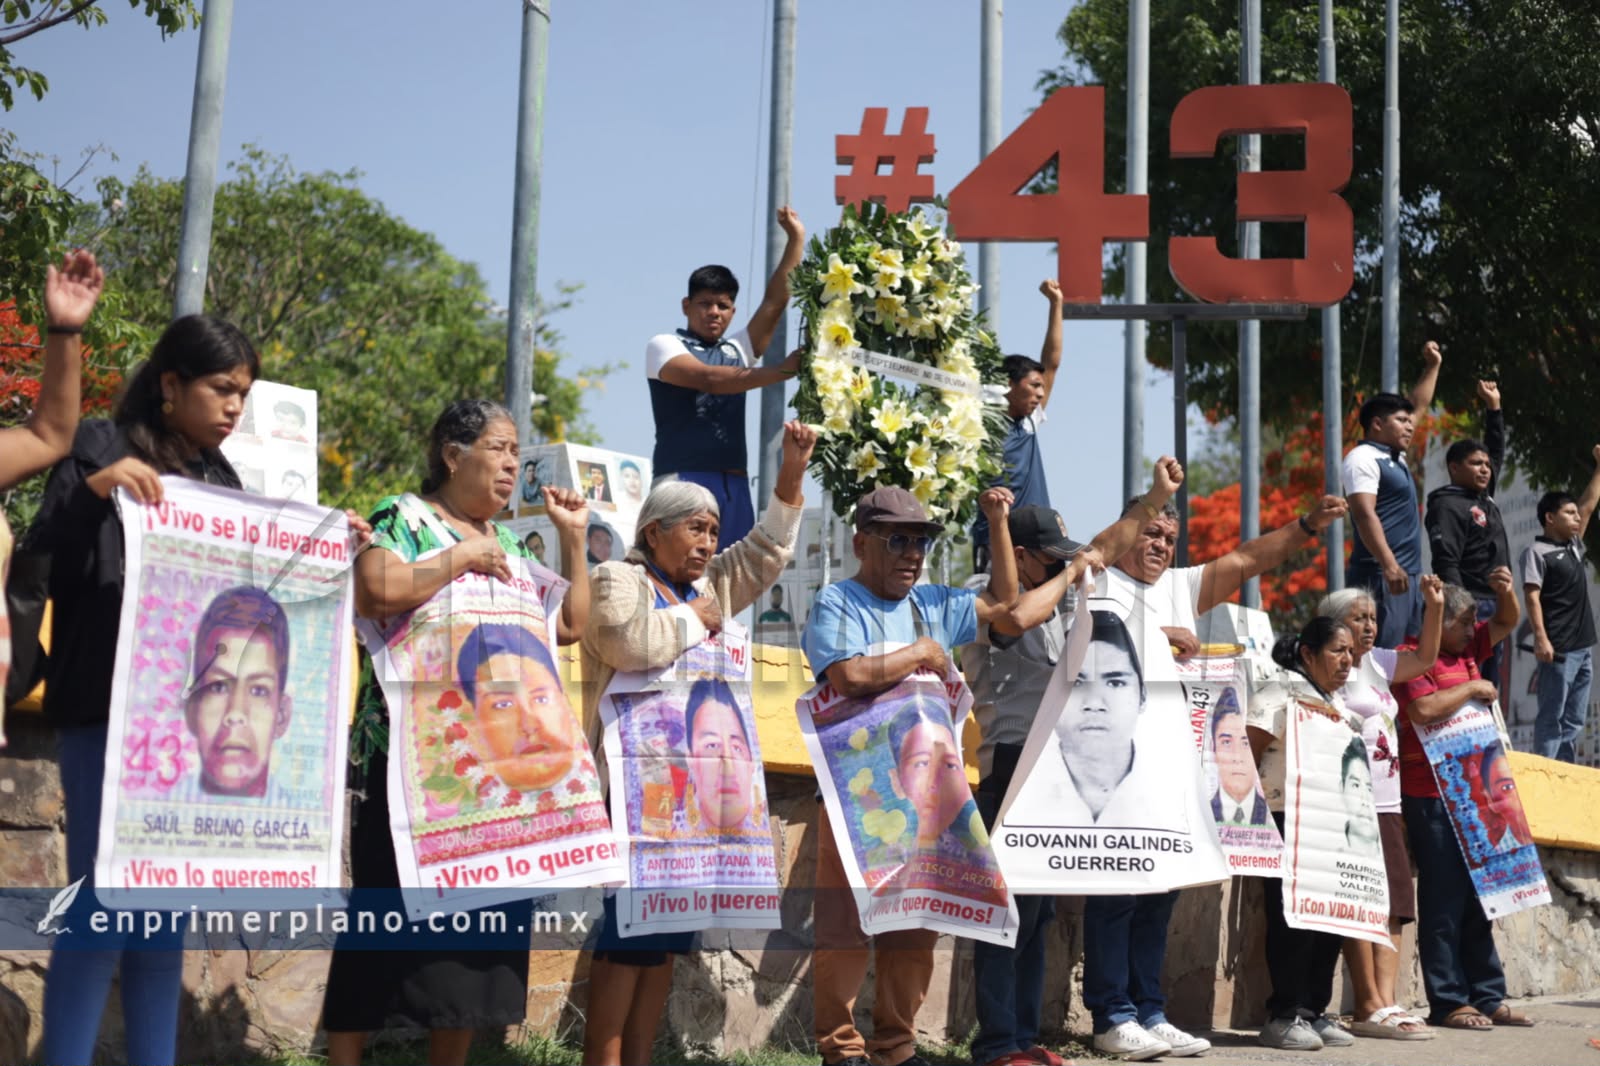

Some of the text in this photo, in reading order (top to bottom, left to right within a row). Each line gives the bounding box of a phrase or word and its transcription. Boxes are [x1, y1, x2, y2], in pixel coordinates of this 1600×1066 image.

[211, 516, 236, 539] se
[242, 516, 261, 545] lo
[267, 520, 350, 563] llevaron!
[125, 733, 182, 787] 43
[143, 811, 311, 840] SAÚL BRUNO GARCÍA
[495, 812, 572, 837] TRUJILLO
[1005, 833, 1193, 854] GIOVANNI GALINDES
[647, 856, 696, 871] ANTONIO
[701, 854, 751, 868] SANTANA
[1048, 855, 1155, 873] GUERRERO
[1229, 853, 1282, 870] queremos!
[1336, 861, 1386, 879] MAURICIO
[124, 860, 317, 895] ¡Vivo lo queremos!
[434, 865, 499, 899] ¡Vivo
[506, 855, 531, 878] lo
[961, 872, 1005, 890] ARZOLA
[1340, 872, 1383, 886] ORTEGA
[1339, 881, 1385, 897] VALERIO
[1511, 888, 1540, 904] ¡Vivo
[642, 892, 689, 921] ¡Vivo
[693, 890, 707, 911] lo
[902, 896, 994, 924] queremos!
[1300, 897, 1325, 915] ¡Con
[1328, 901, 1356, 921] VIDA
